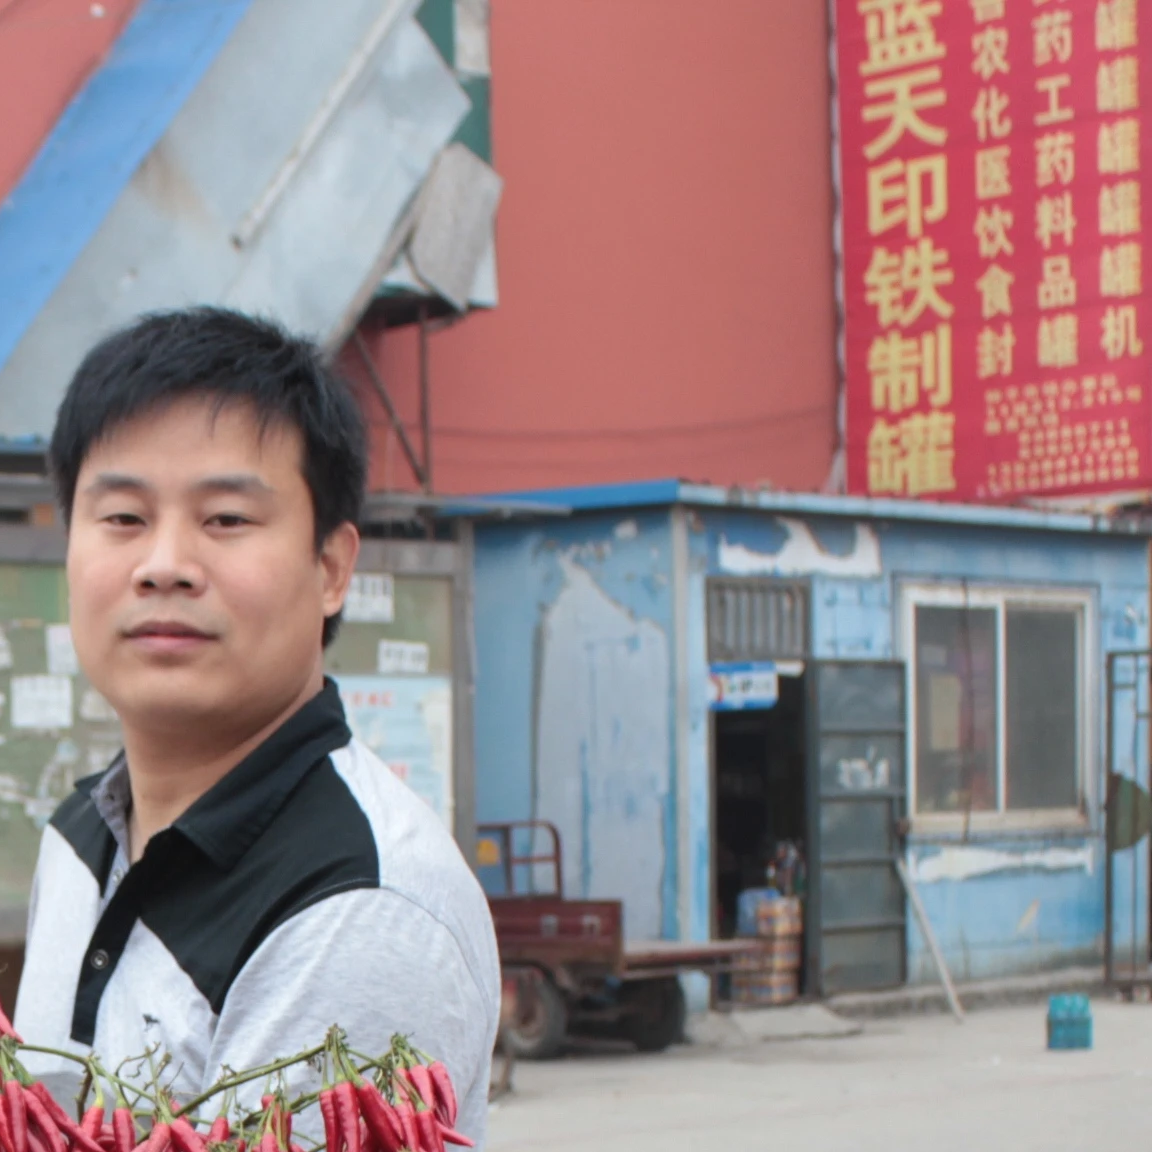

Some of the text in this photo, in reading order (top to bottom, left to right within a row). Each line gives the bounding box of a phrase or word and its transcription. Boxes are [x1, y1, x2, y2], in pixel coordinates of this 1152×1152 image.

[858, 0, 955, 496] 蓝天印铁制罐
